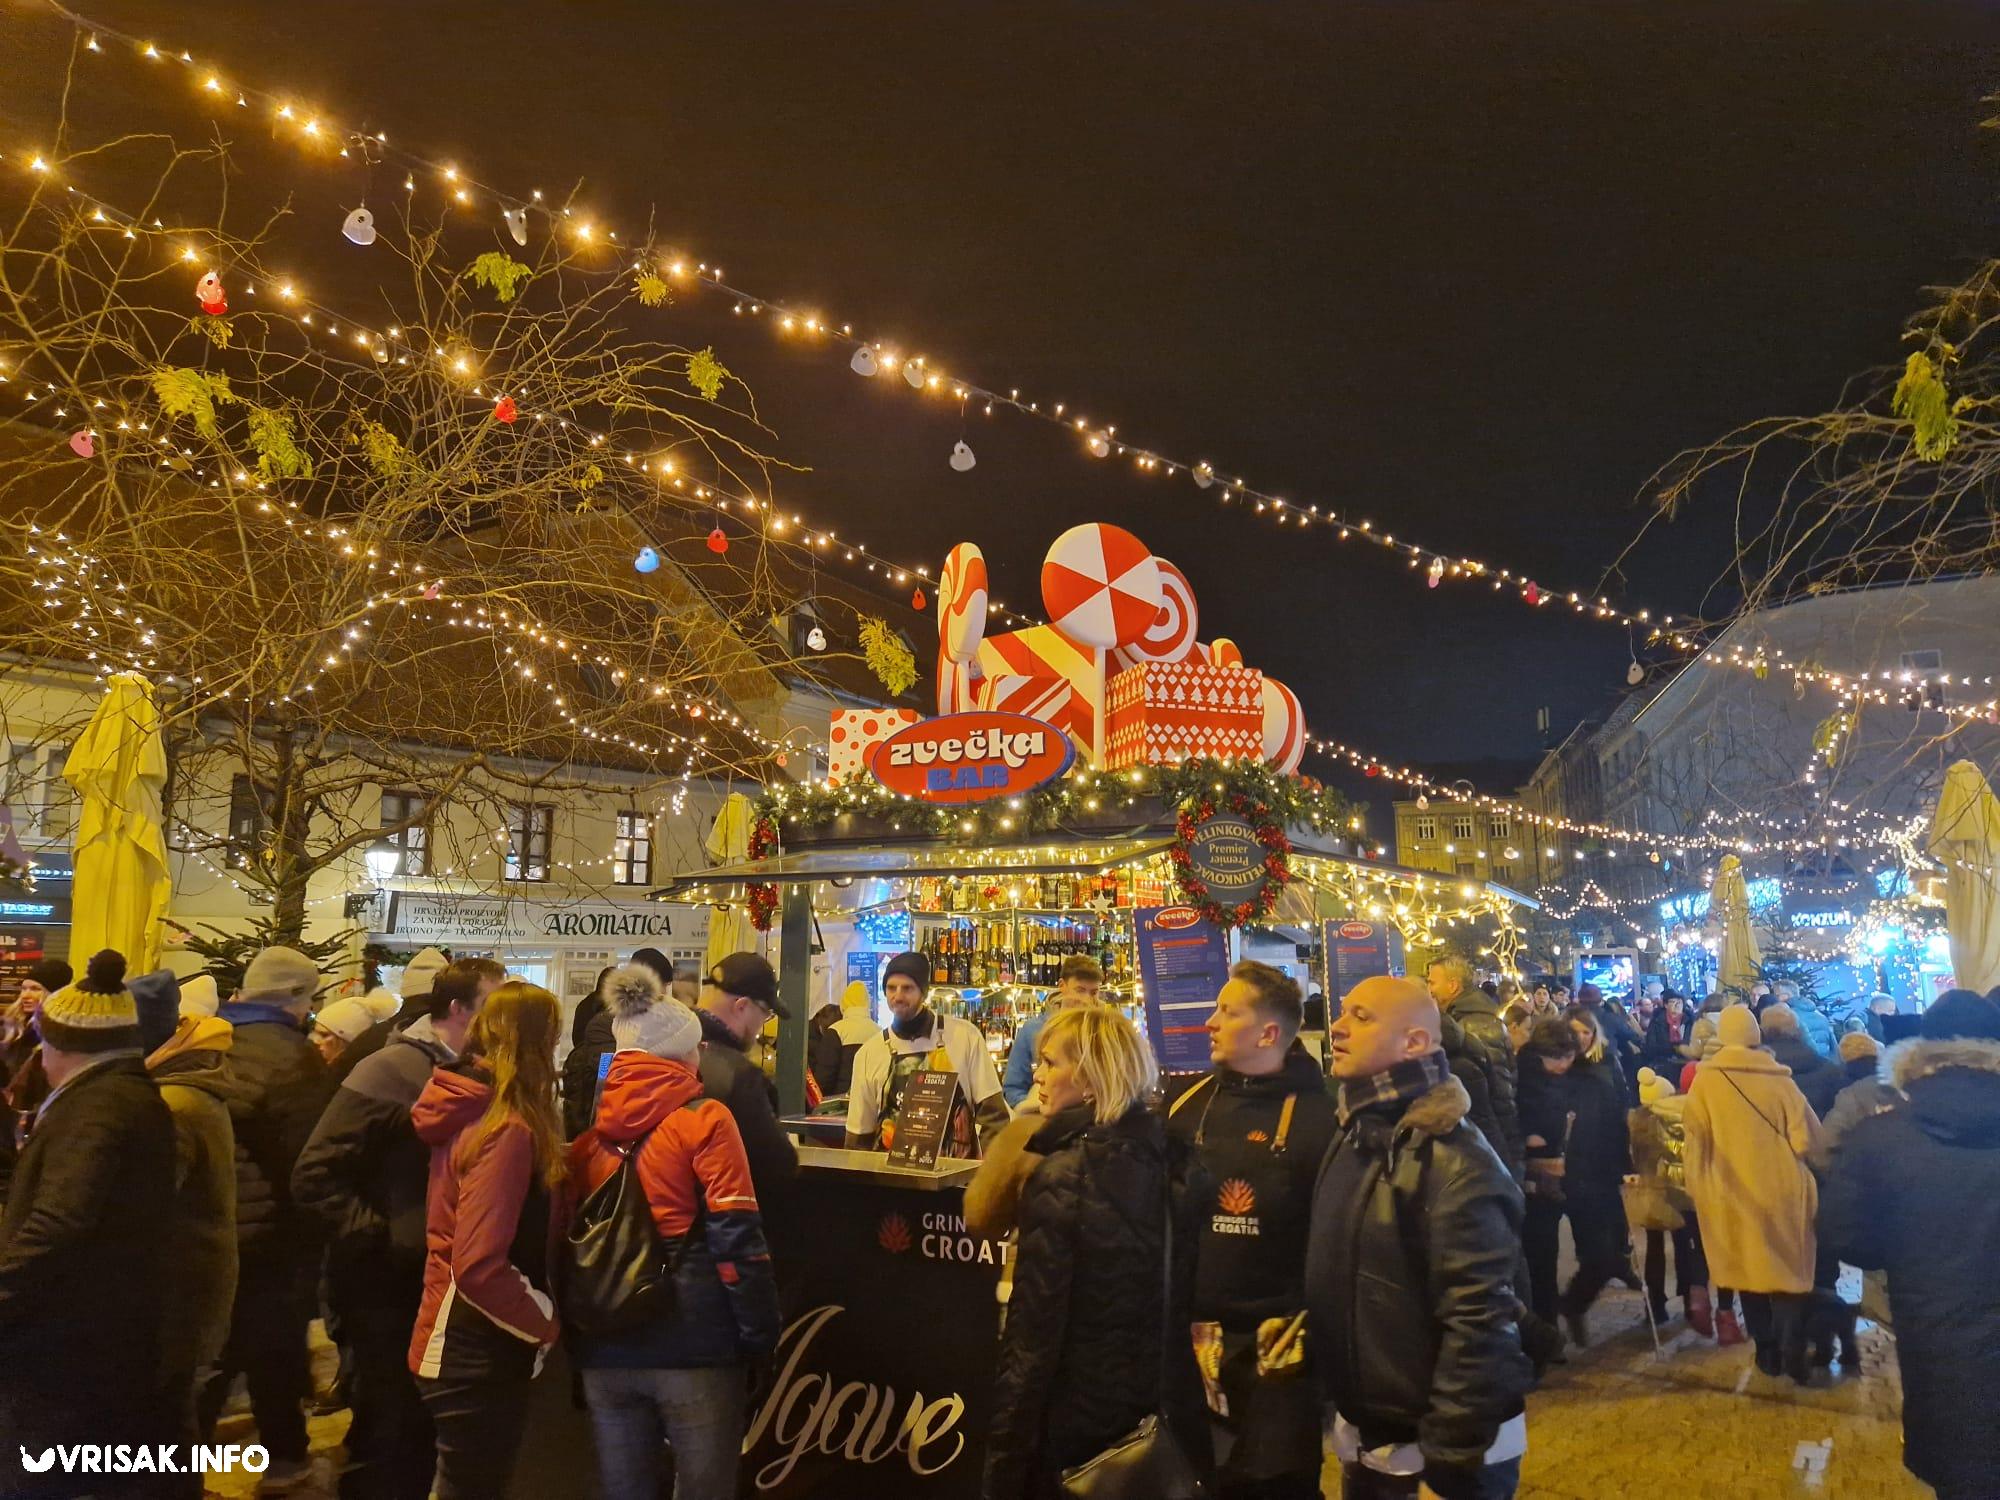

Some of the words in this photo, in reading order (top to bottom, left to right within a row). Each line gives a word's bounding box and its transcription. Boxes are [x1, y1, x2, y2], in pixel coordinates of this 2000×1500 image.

[890, 728, 1044, 768] zvečka
[927, 764, 1009, 791] BAR
[1209, 843, 1249, 854] Premier
[1210, 856, 1249, 867] Premier
[1193, 862, 1266, 885] PELINKOVAC
[396, 926, 433, 935] IRODNO
[542, 913, 672, 936] AROMATICA
[922, 1213, 967, 1233] GRIN
[1212, 1222, 1260, 1236] CROATIA
[921, 1234, 1009, 1265] CROAT
